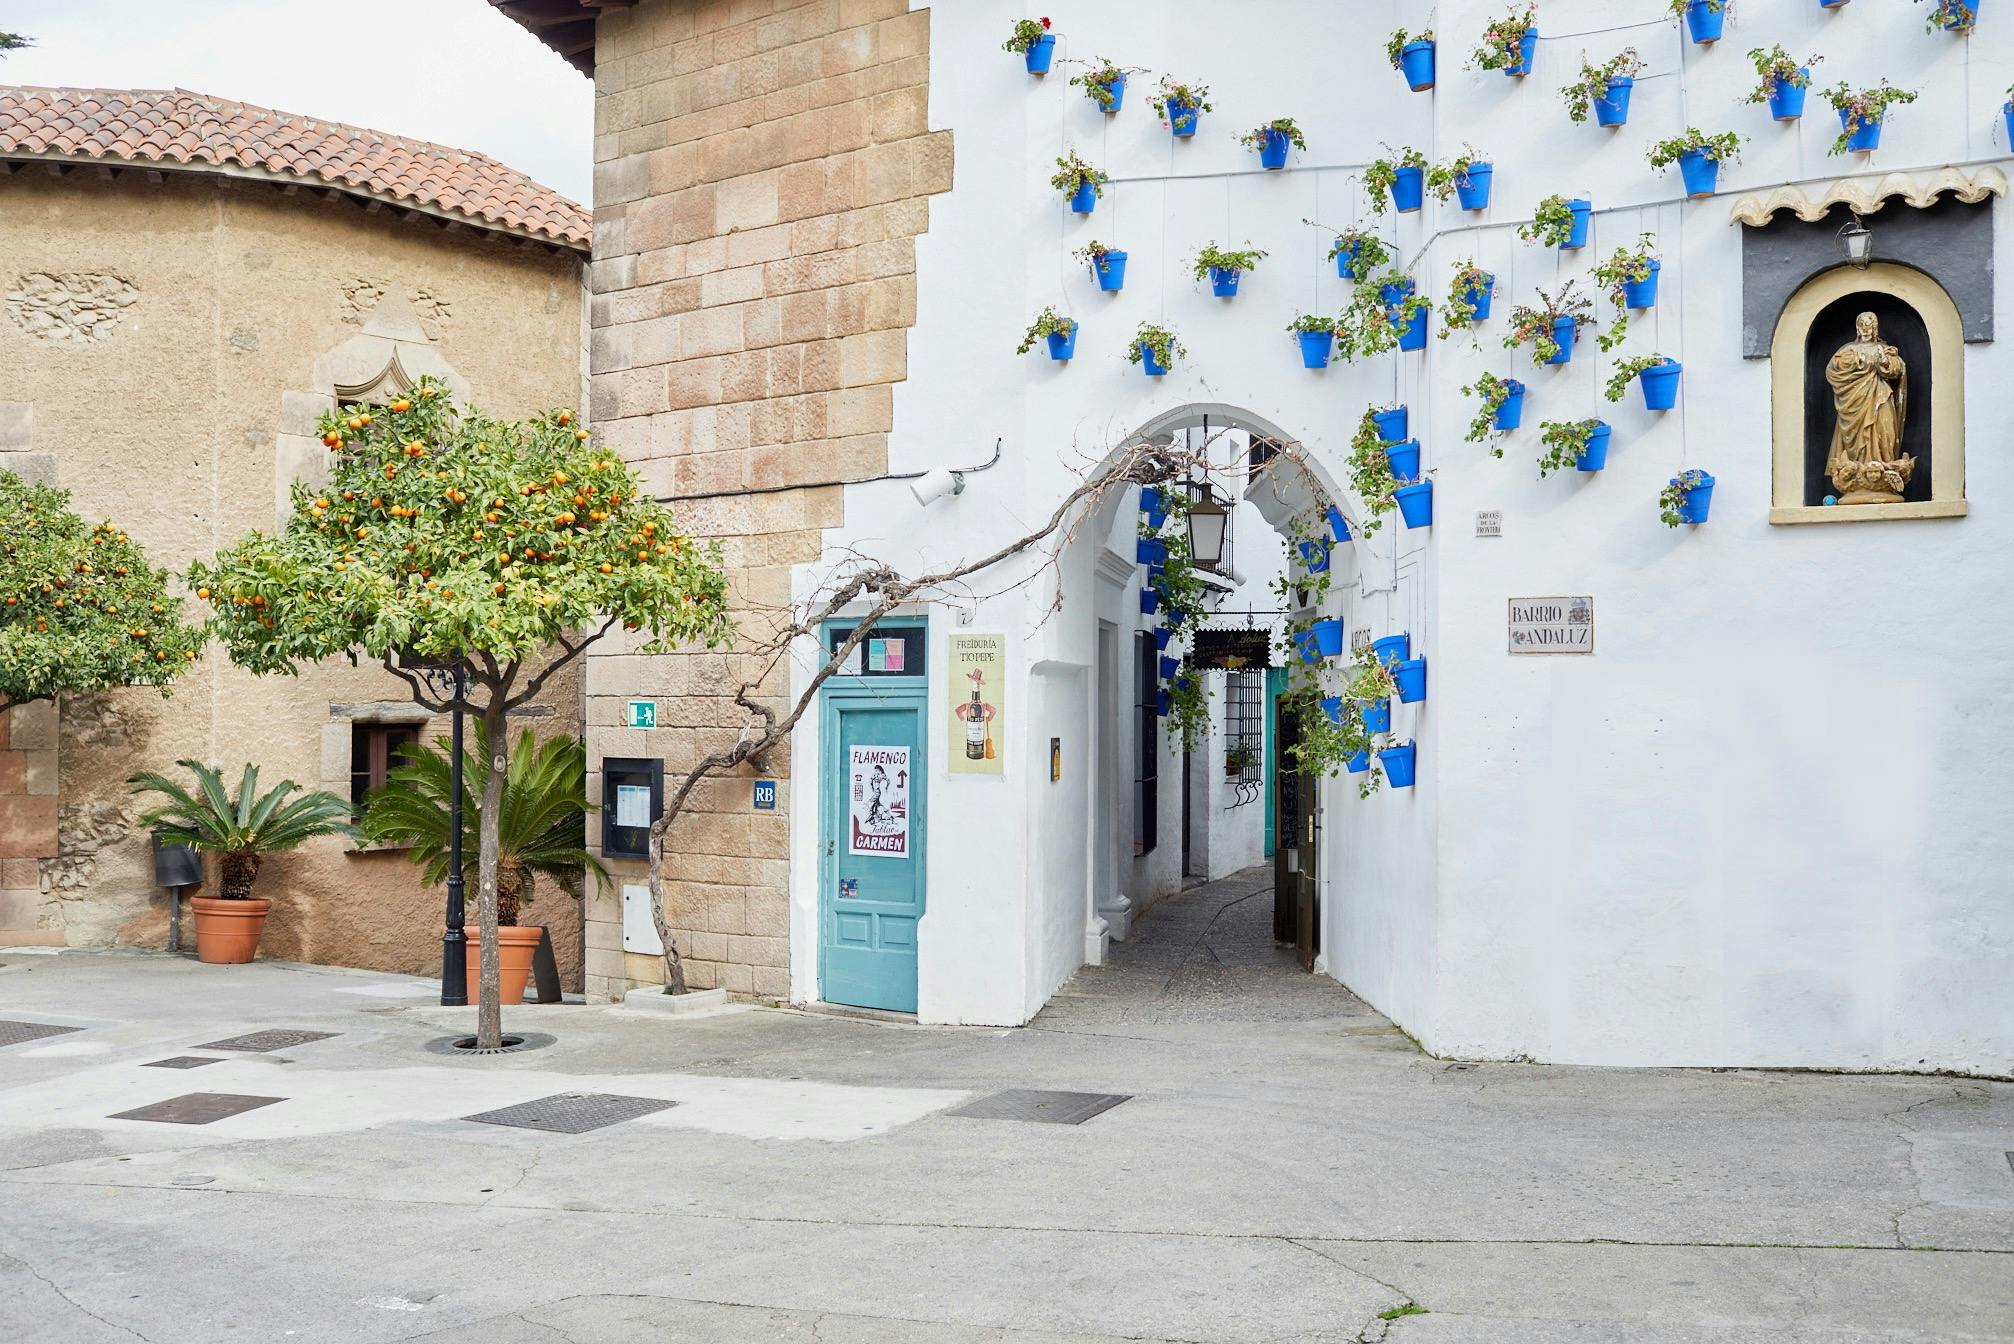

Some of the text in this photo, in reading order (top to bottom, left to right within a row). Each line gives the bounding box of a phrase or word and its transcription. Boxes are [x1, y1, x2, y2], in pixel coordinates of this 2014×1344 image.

[1478, 512, 1500, 520] ARCOS
[1512, 606, 1562, 622] BARRIO
[1526, 628, 1588, 645] ANDALUZ
[853, 751, 907, 765] FLAMENCO
[755, 787, 774, 802] RB
[855, 835, 903, 851] CARMEN
